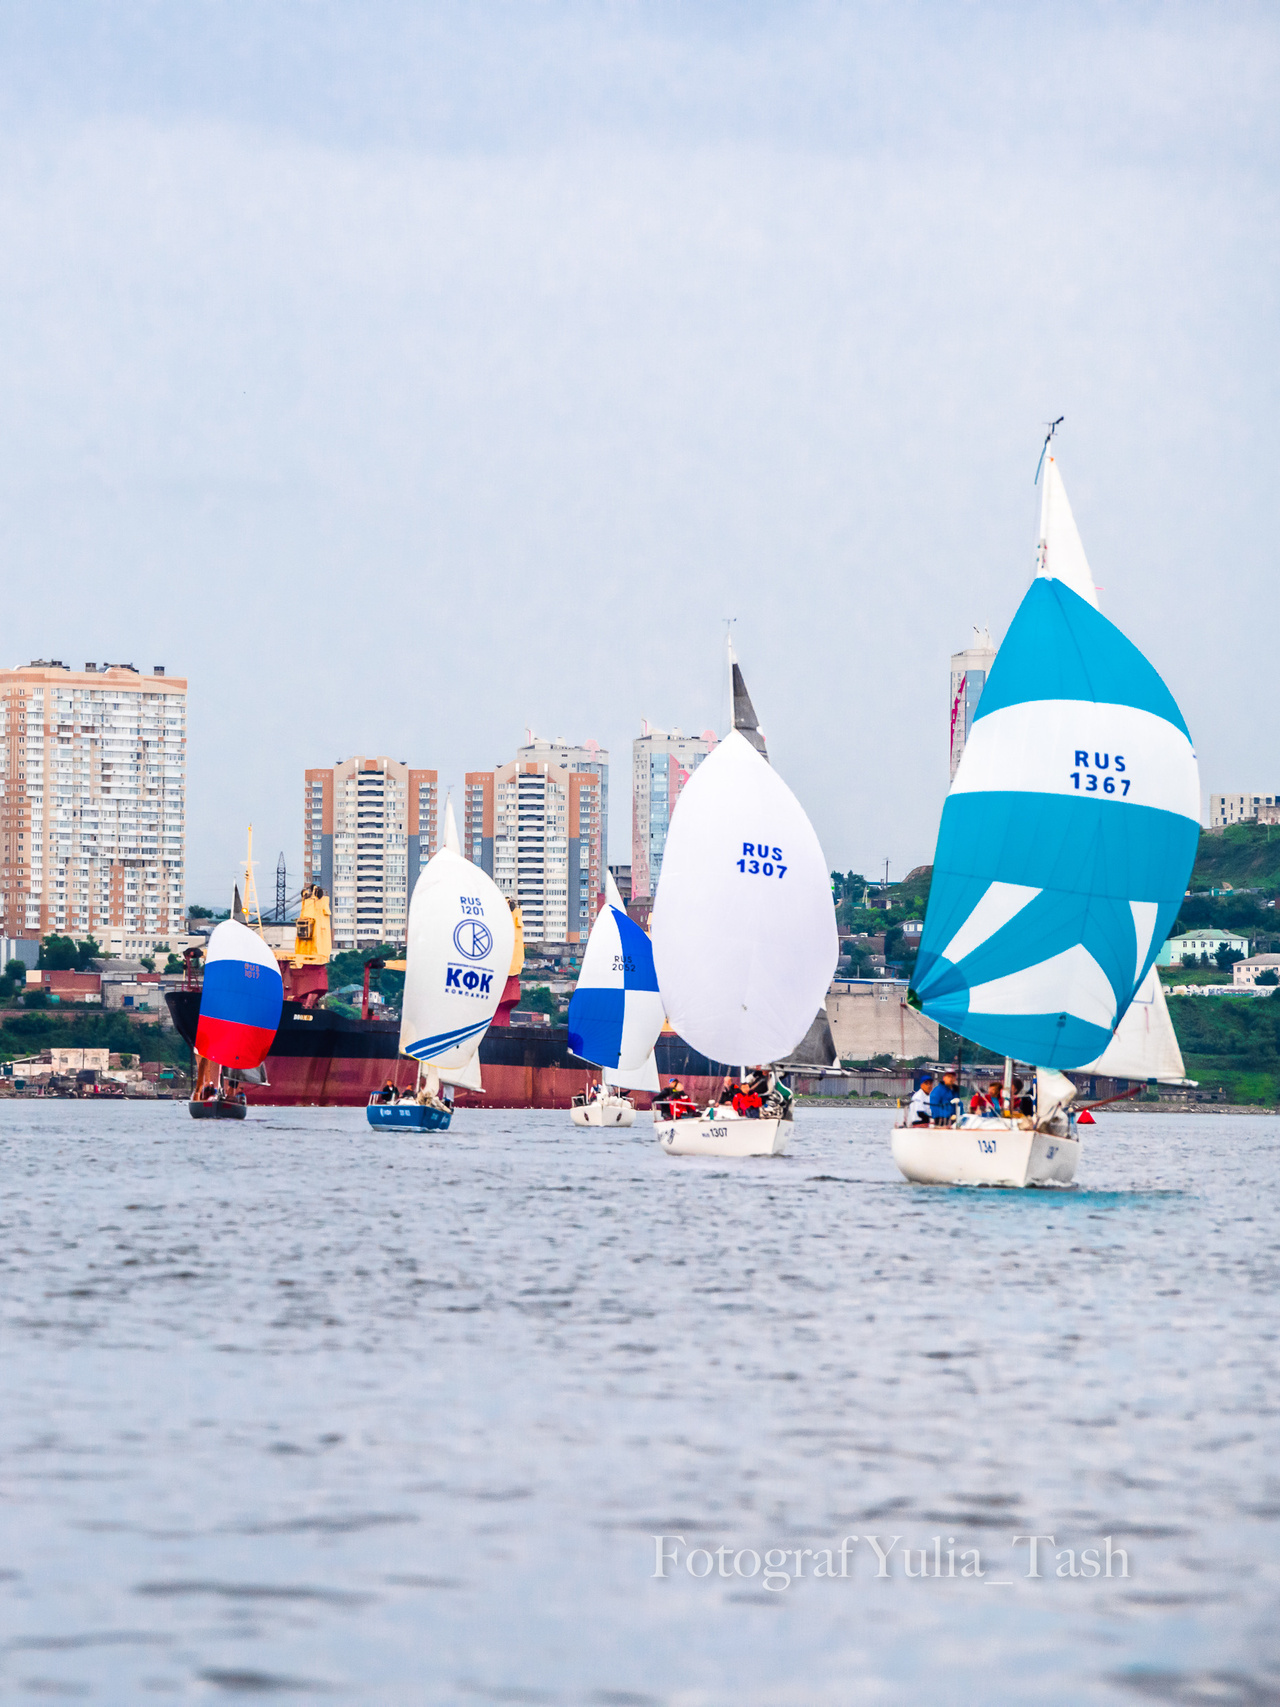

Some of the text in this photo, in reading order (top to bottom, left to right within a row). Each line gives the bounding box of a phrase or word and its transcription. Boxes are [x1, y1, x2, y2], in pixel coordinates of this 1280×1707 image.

[1074, 749, 1126, 773] RUS
[1069, 771, 1131, 797] 1367
[742, 841, 783, 862] RUS
[736, 858, 788, 879] 1307
[459, 895, 482, 907] RUS
[461, 904, 485, 917] 1201
[613, 955, 633, 964] RUS
[612, 963, 637, 973] 2052
[445, 966, 494, 994] КФК
[710, 1127, 728, 1138] 1307
[977, 1139, 997, 1154] 1367
